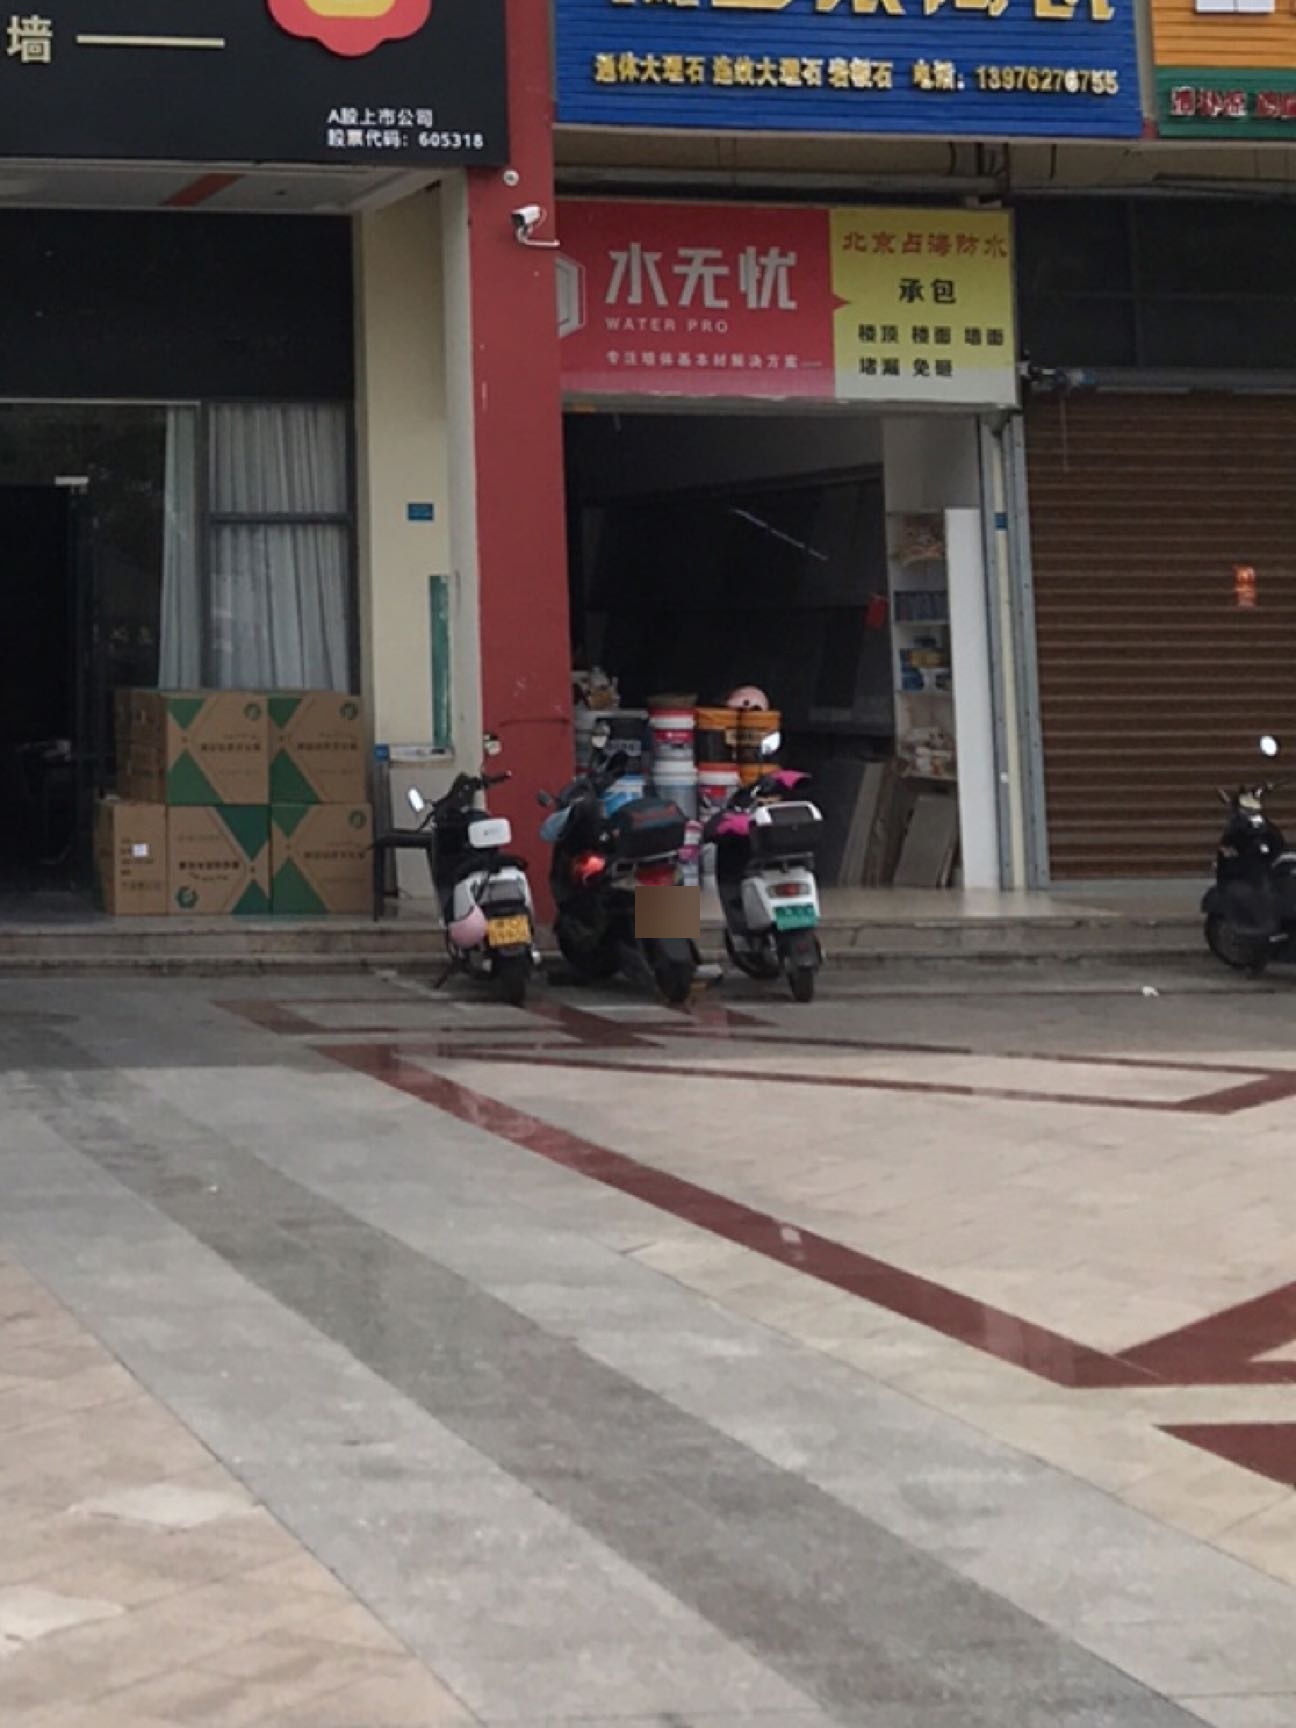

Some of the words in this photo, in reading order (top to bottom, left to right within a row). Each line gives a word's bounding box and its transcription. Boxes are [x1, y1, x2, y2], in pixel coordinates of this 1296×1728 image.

[326, 107, 434, 129] A股上市公司
[604, 243, 798, 310] 水无忧
[898, 277, 958, 305] 承包
[605, 317, 676, 332] WATER
[687, 319, 728, 333] PRO
